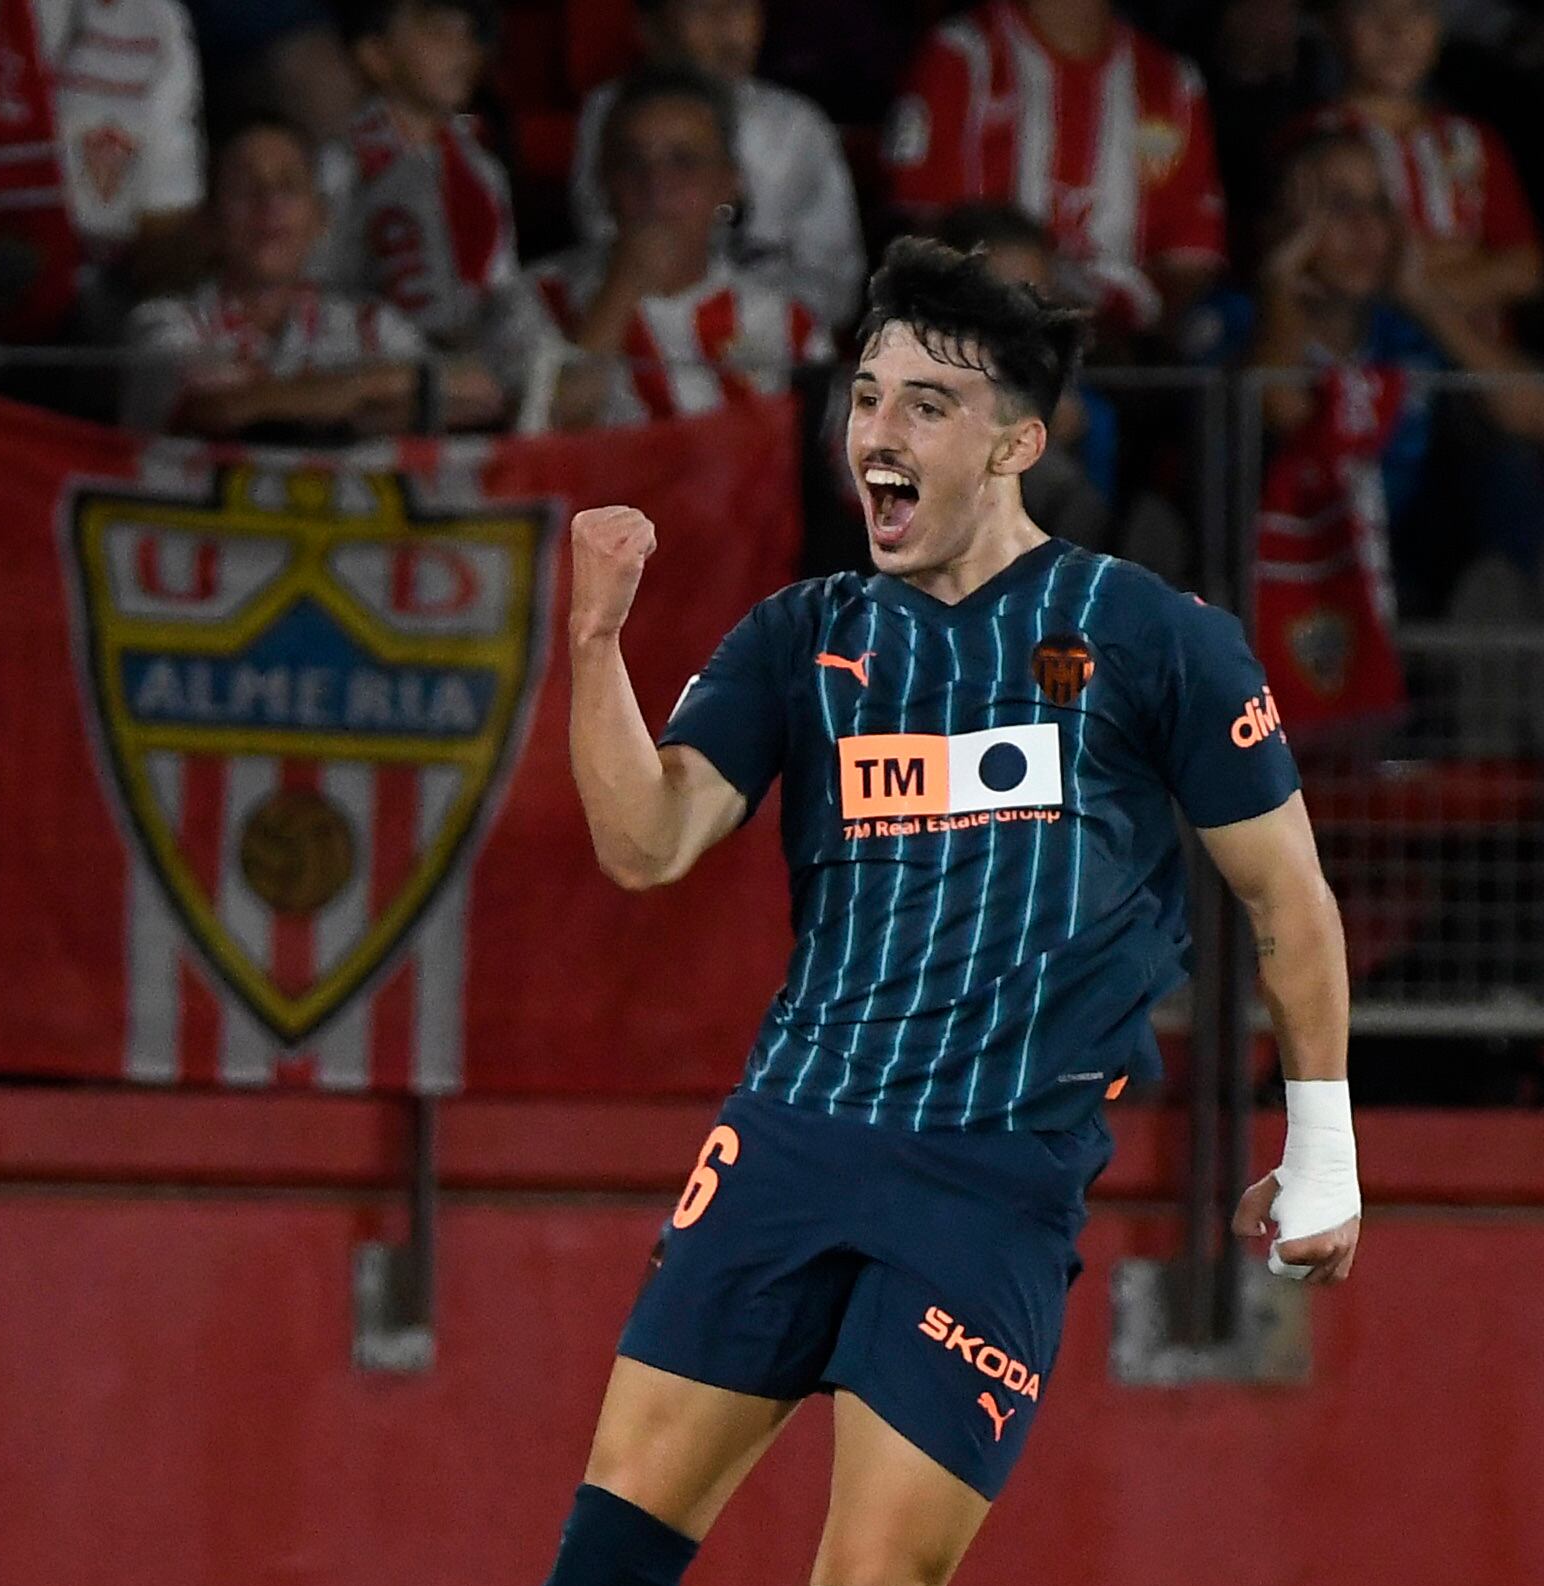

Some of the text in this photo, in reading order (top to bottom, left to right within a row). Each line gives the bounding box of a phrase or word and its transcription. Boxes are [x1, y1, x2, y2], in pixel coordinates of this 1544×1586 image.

[135, 534, 480, 614] U D
[854, 758, 925, 798] TM
[876, 817, 920, 838] Real
[927, 813, 990, 832] Estate
